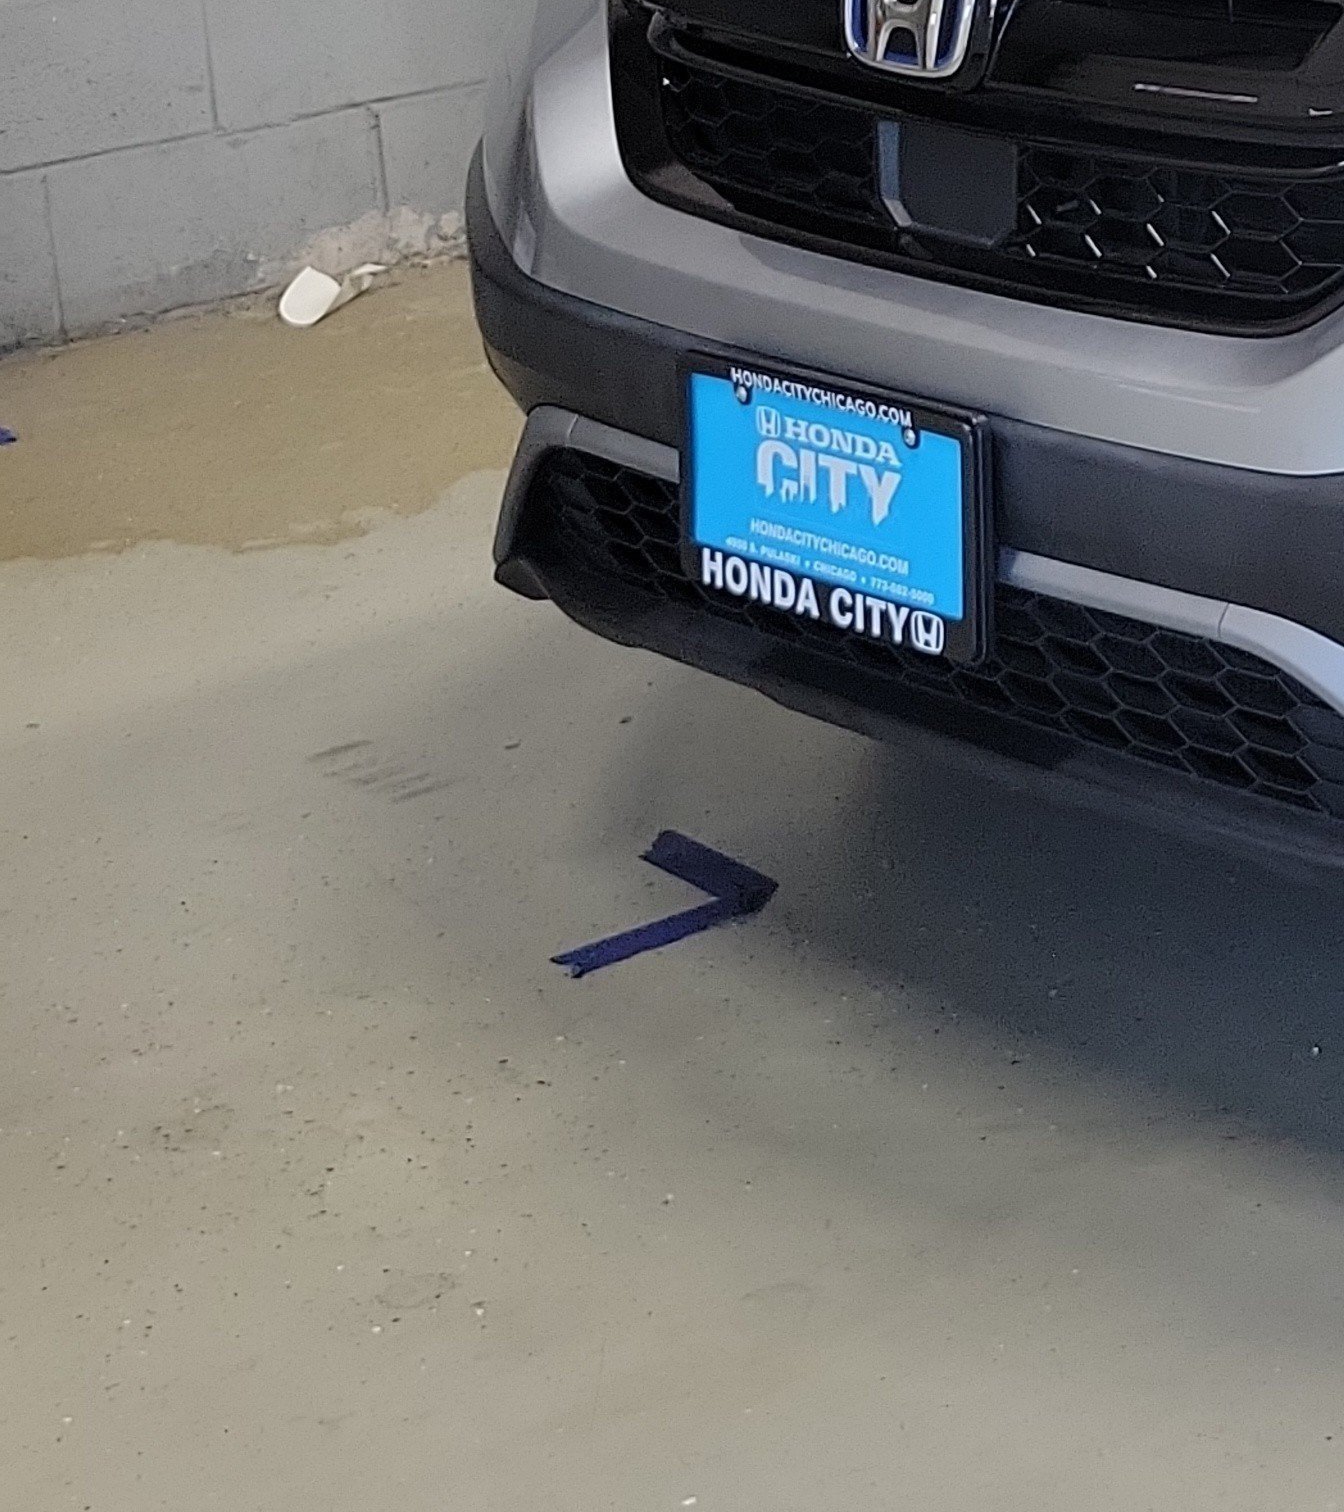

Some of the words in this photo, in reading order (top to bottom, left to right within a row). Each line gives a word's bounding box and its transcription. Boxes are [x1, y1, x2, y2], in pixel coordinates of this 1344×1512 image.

[730, 367, 912, 427] HONDACITYCHICAGO.COM
[784, 416, 902, 467] HONDA
[757, 438, 901, 527] CITY
[751, 518, 909, 575] HONDACITYCHICAGO.COM
[813, 560, 857, 582] CHICAGO
[702, 547, 820, 619] HONDA
[830, 587, 911, 644] CITY
